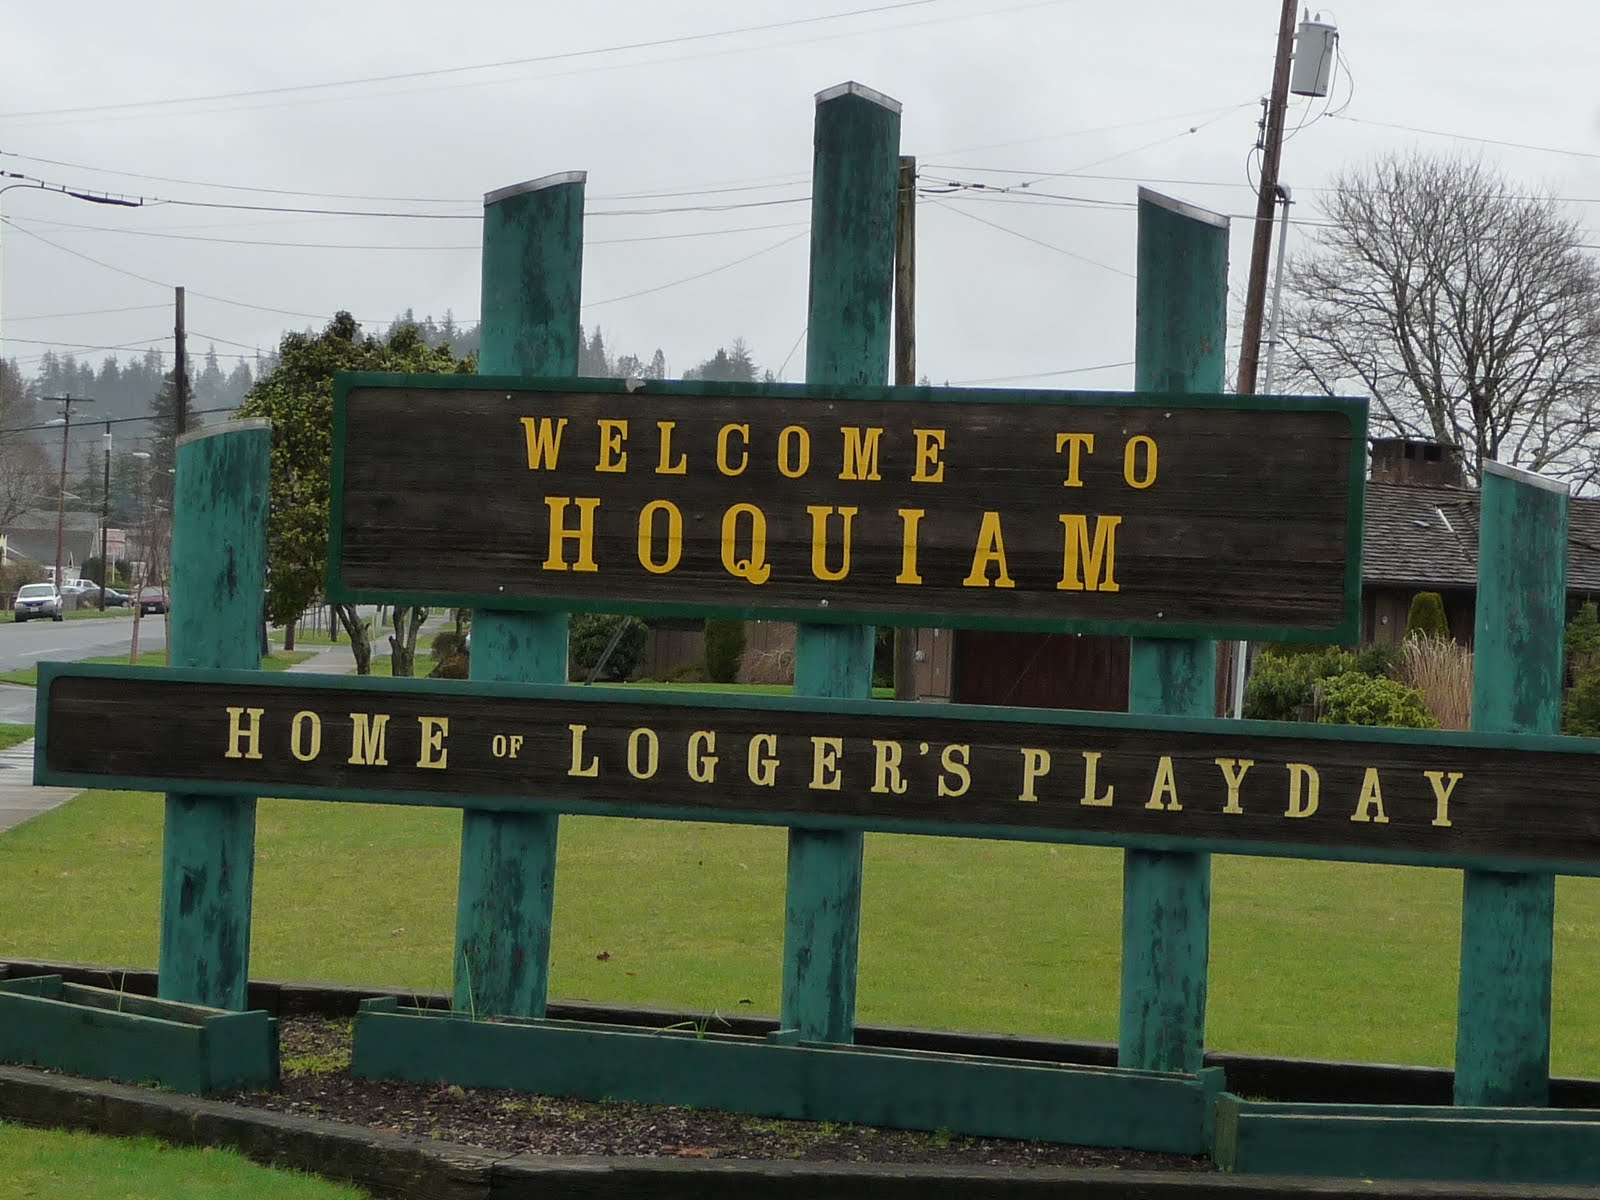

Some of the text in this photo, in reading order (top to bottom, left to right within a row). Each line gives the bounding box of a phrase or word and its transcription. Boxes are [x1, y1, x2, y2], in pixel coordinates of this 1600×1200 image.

[520, 416, 1159, 490] WELCOME TO
[541, 495, 1123, 593] HOQUIAM
[224, 706, 1465, 828] HOME OF LOGGER'S PLAYDAY
